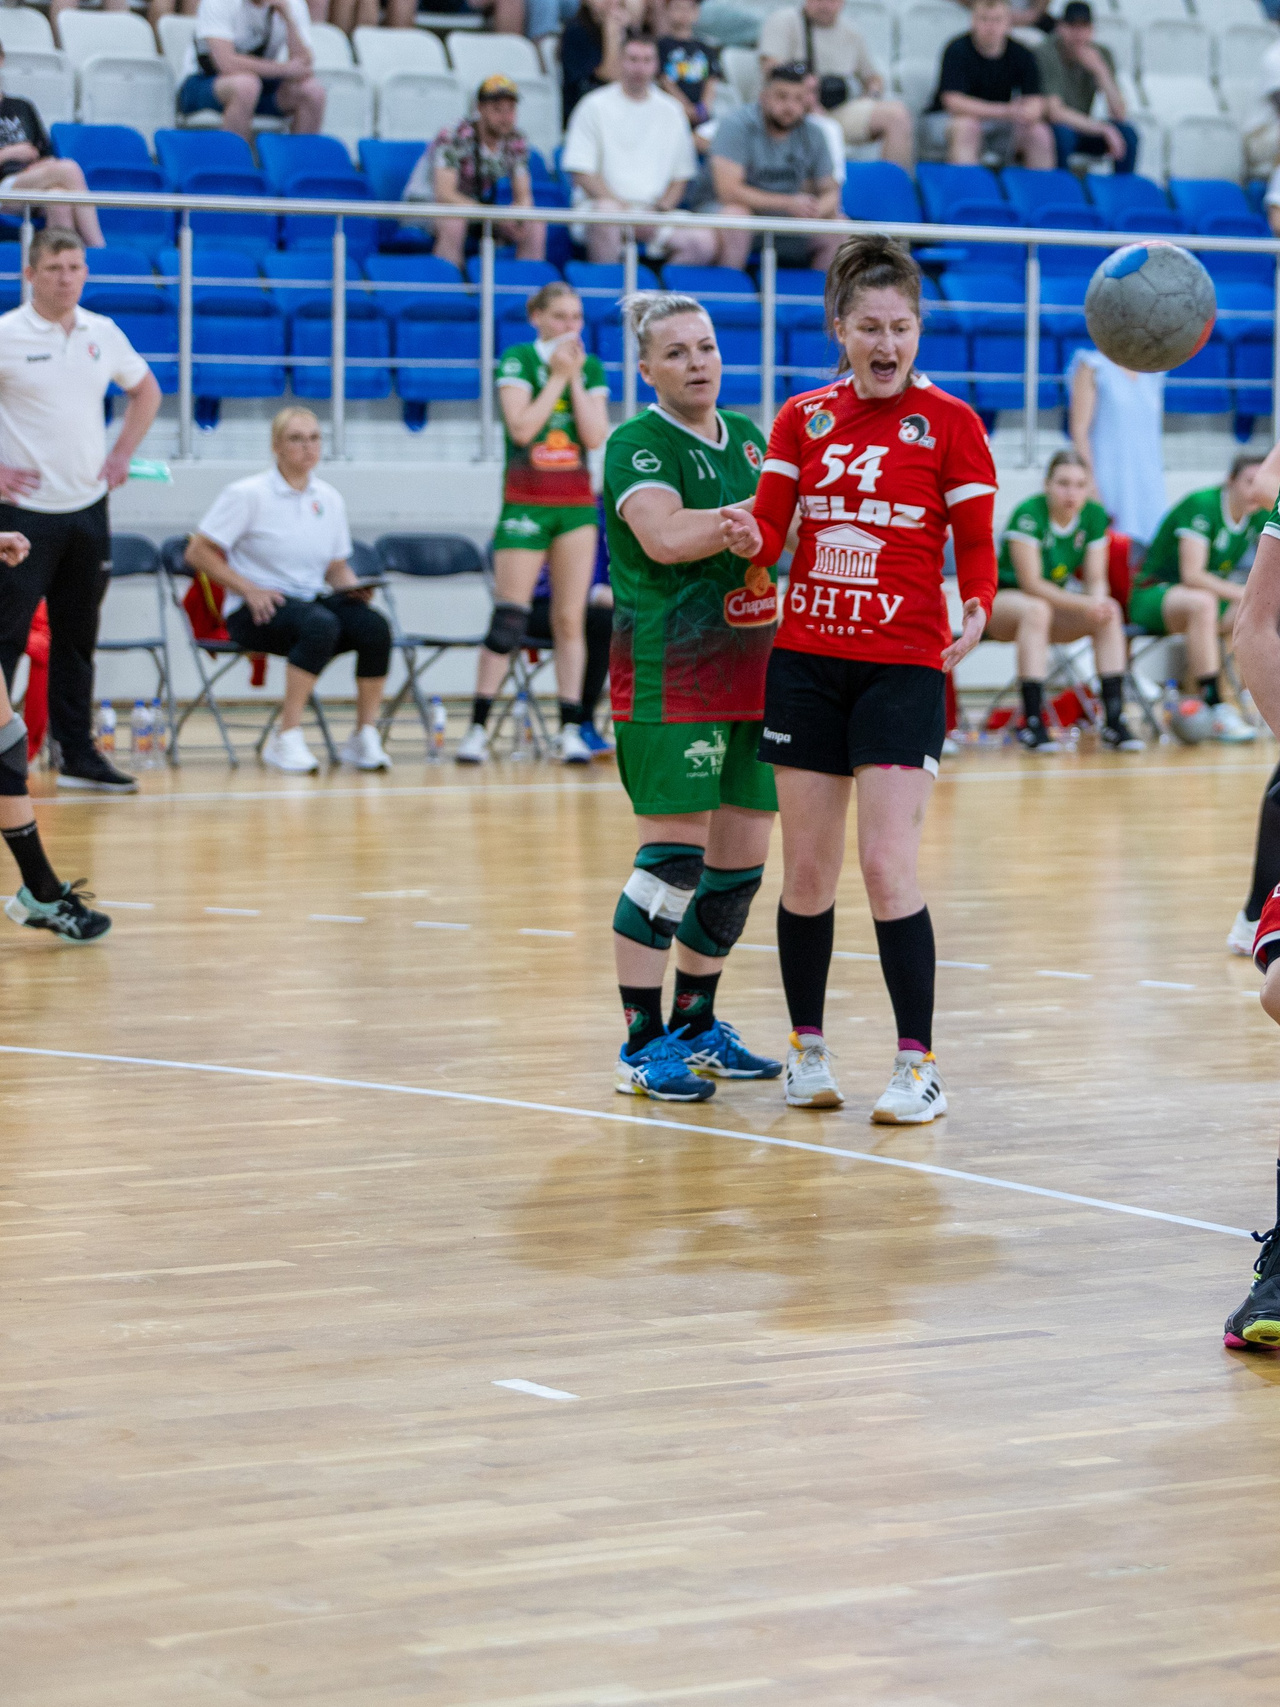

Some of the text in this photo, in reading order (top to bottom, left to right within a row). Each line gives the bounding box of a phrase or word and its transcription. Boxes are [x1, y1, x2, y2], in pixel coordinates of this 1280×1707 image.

[689, 449, 716, 480] 11
[815, 443, 889, 492] 54
[790, 582, 904, 624] БНТУ
